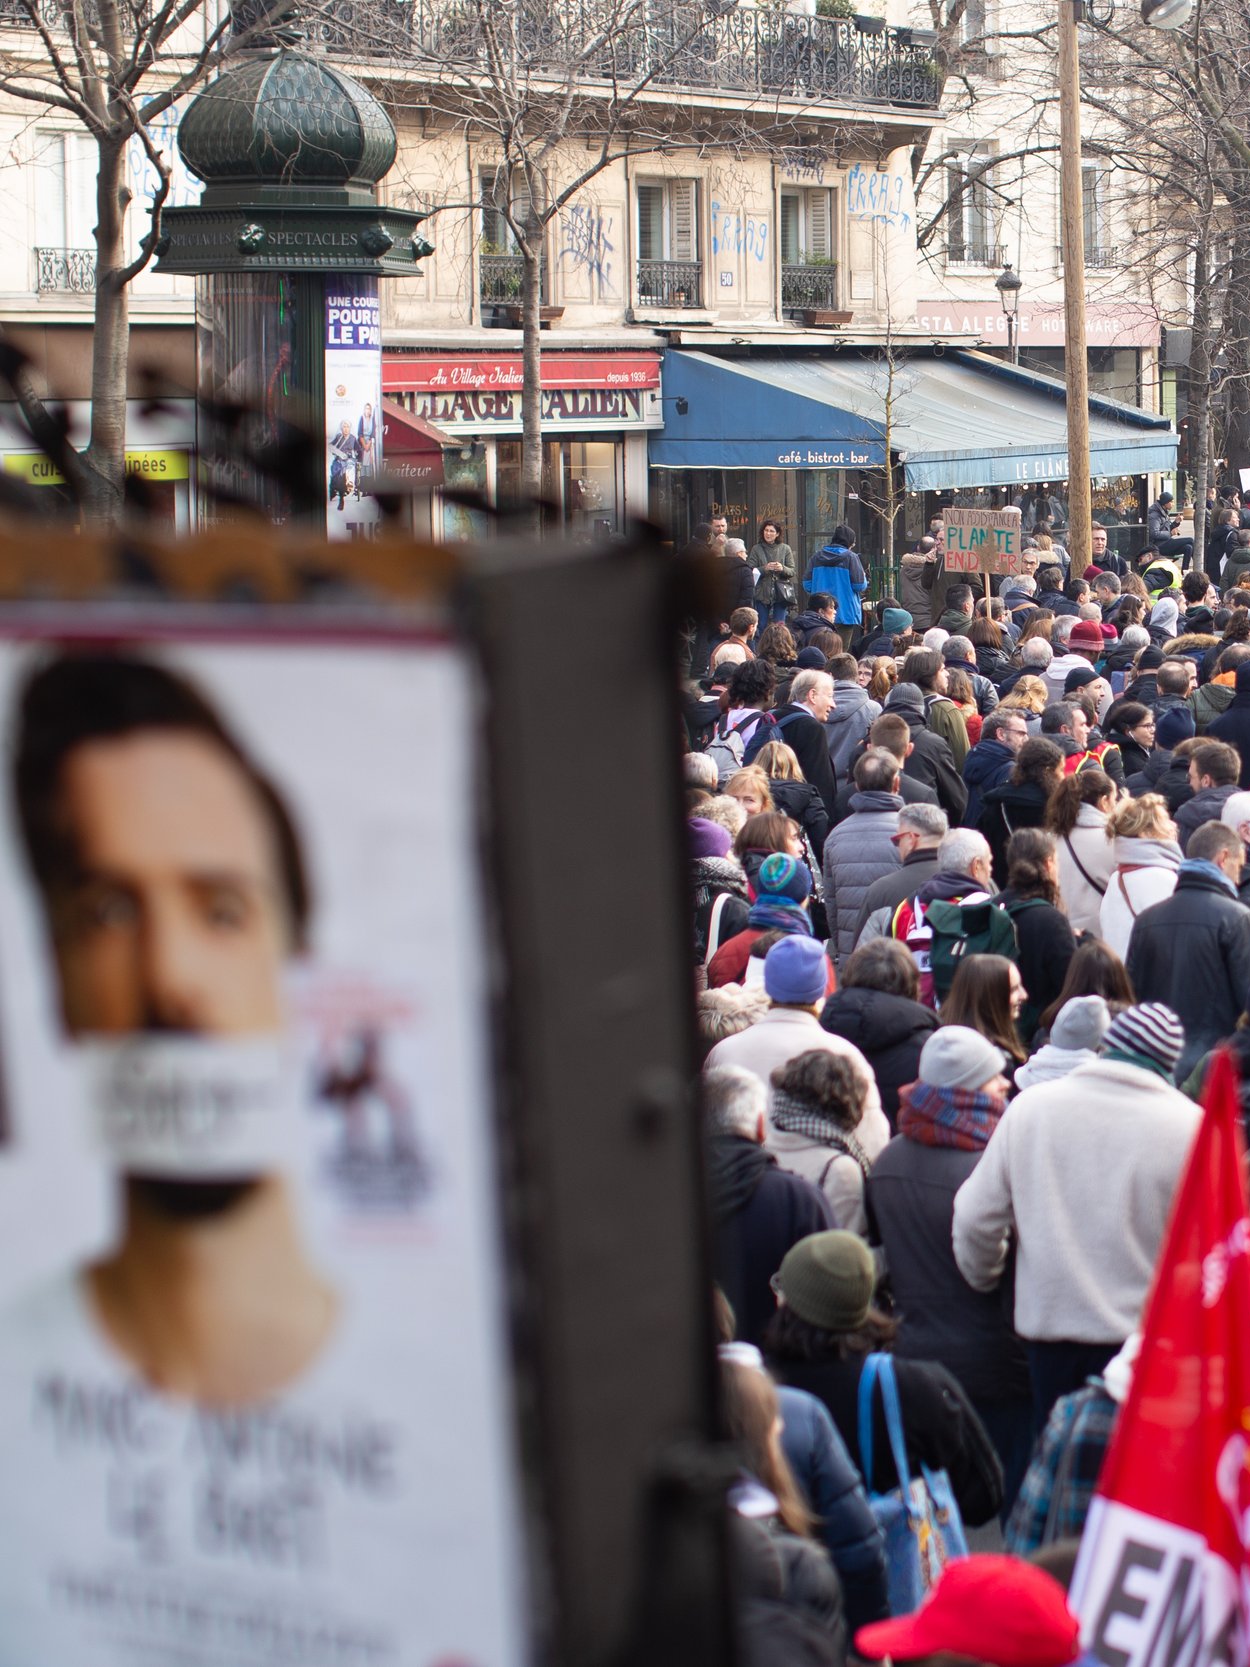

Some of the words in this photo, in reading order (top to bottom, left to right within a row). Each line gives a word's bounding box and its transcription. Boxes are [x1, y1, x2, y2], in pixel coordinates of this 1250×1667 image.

[268, 231, 359, 247] SPECTACLES
[720, 273, 732, 286] 50
[328, 296, 351, 307] UNE
[328, 309, 371, 325] POUR
[914, 316, 953, 332] STA
[328, 326, 353, 345] LE
[429, 368, 448, 385] Au
[450, 367, 486, 388] Village
[606, 371, 629, 384] depuis
[630, 372, 646, 383] 1936
[1016, 462, 1028, 479] LE
[1035, 457, 1070, 478] FLÂNE
[945, 510, 965, 526] NON
[947, 526, 1015, 554] PLANTE
[946, 551, 965, 571] EN
